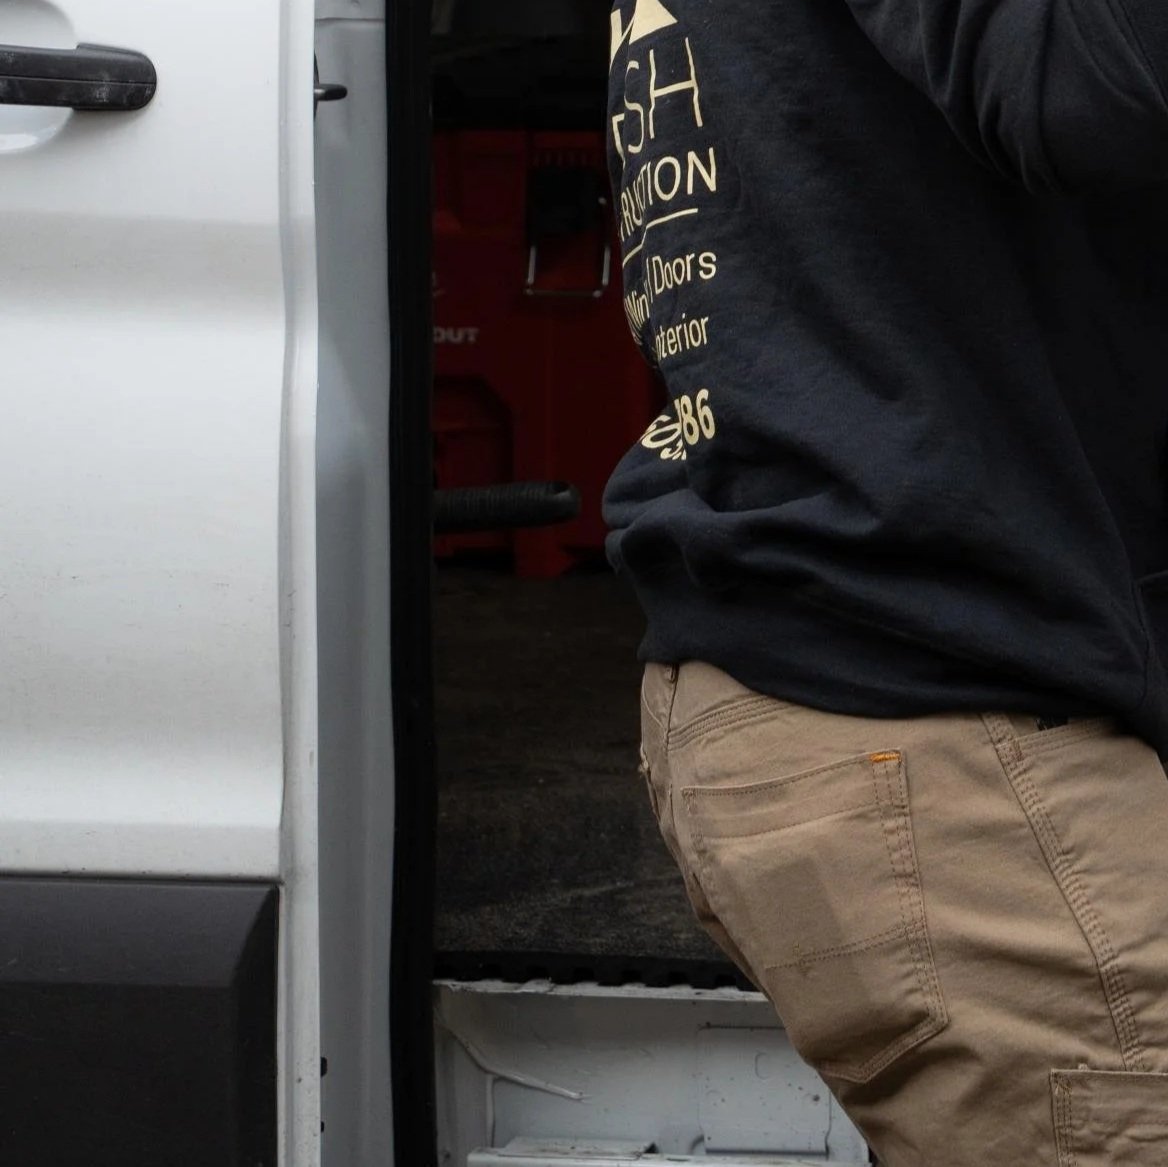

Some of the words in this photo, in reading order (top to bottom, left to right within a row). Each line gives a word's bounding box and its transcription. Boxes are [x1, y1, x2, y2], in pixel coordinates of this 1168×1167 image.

[620, 146, 718, 242] RUCTION
[652, 251, 717, 296] Doors
[655, 313, 709, 361] nterior
